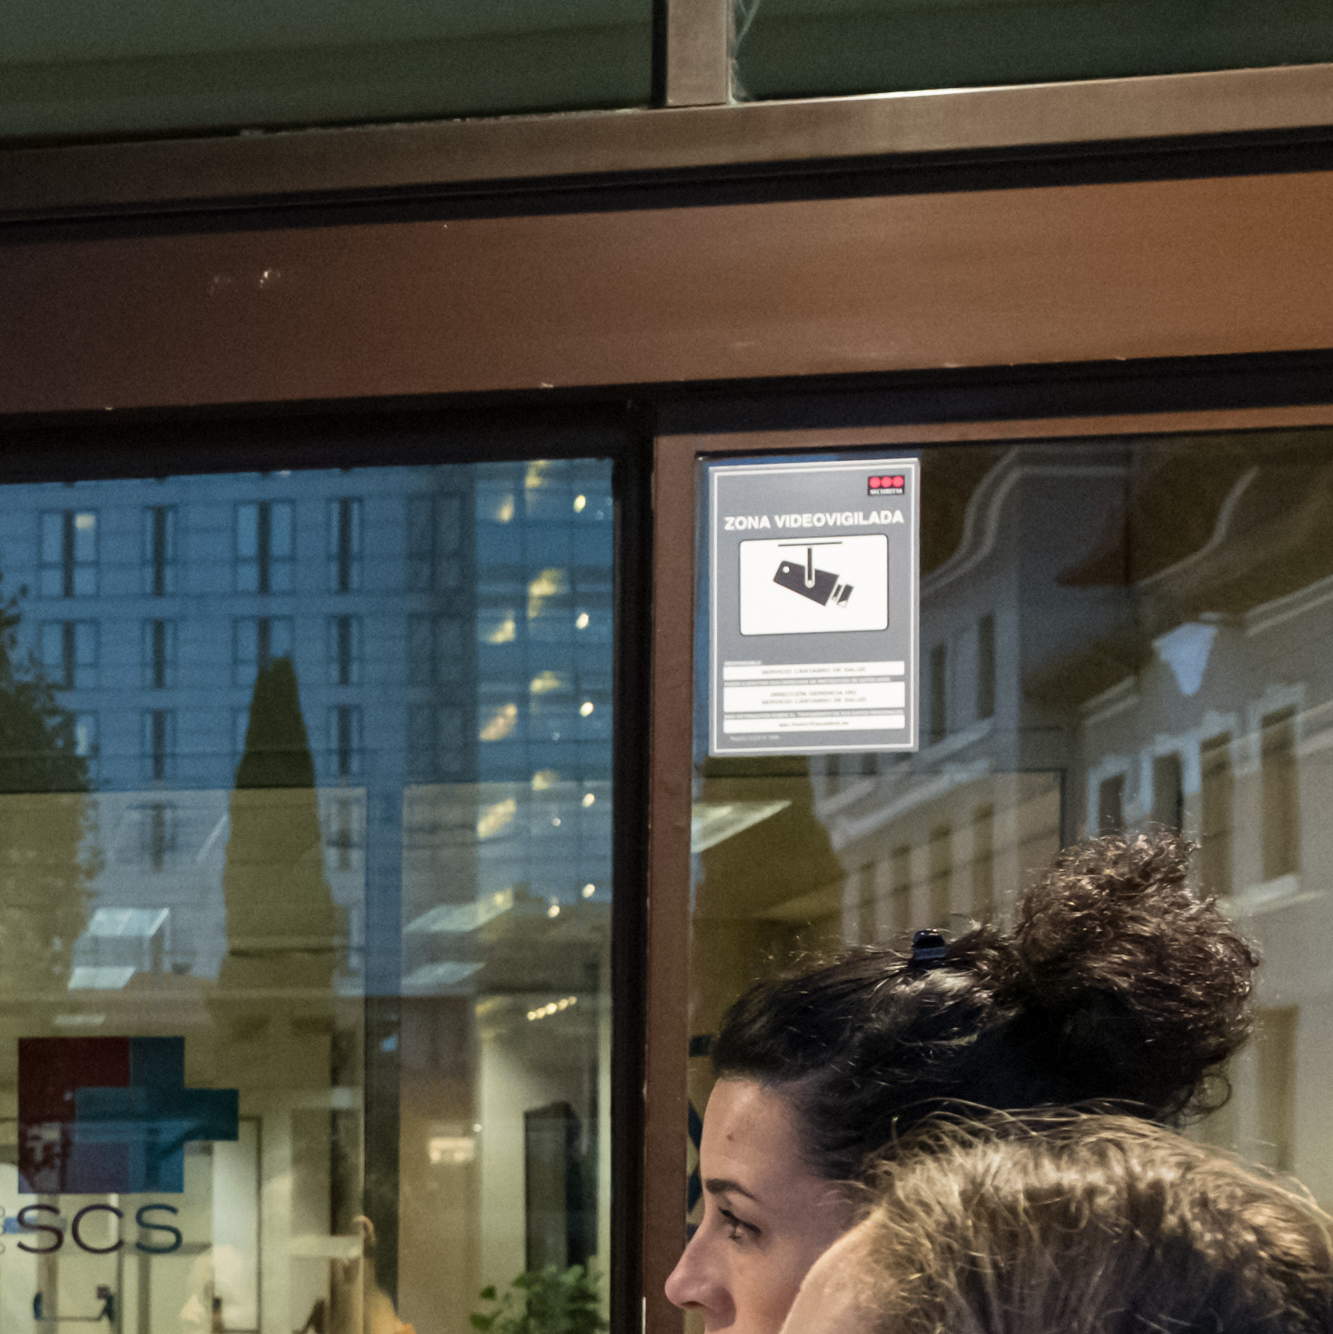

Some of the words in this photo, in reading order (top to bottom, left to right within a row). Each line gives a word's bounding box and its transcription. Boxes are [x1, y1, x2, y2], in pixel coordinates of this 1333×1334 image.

[724, 515, 771, 531] ZONA
[774, 510, 904, 529] VIDEOVIGILADA
[16, 1203, 183, 1255] SCS
